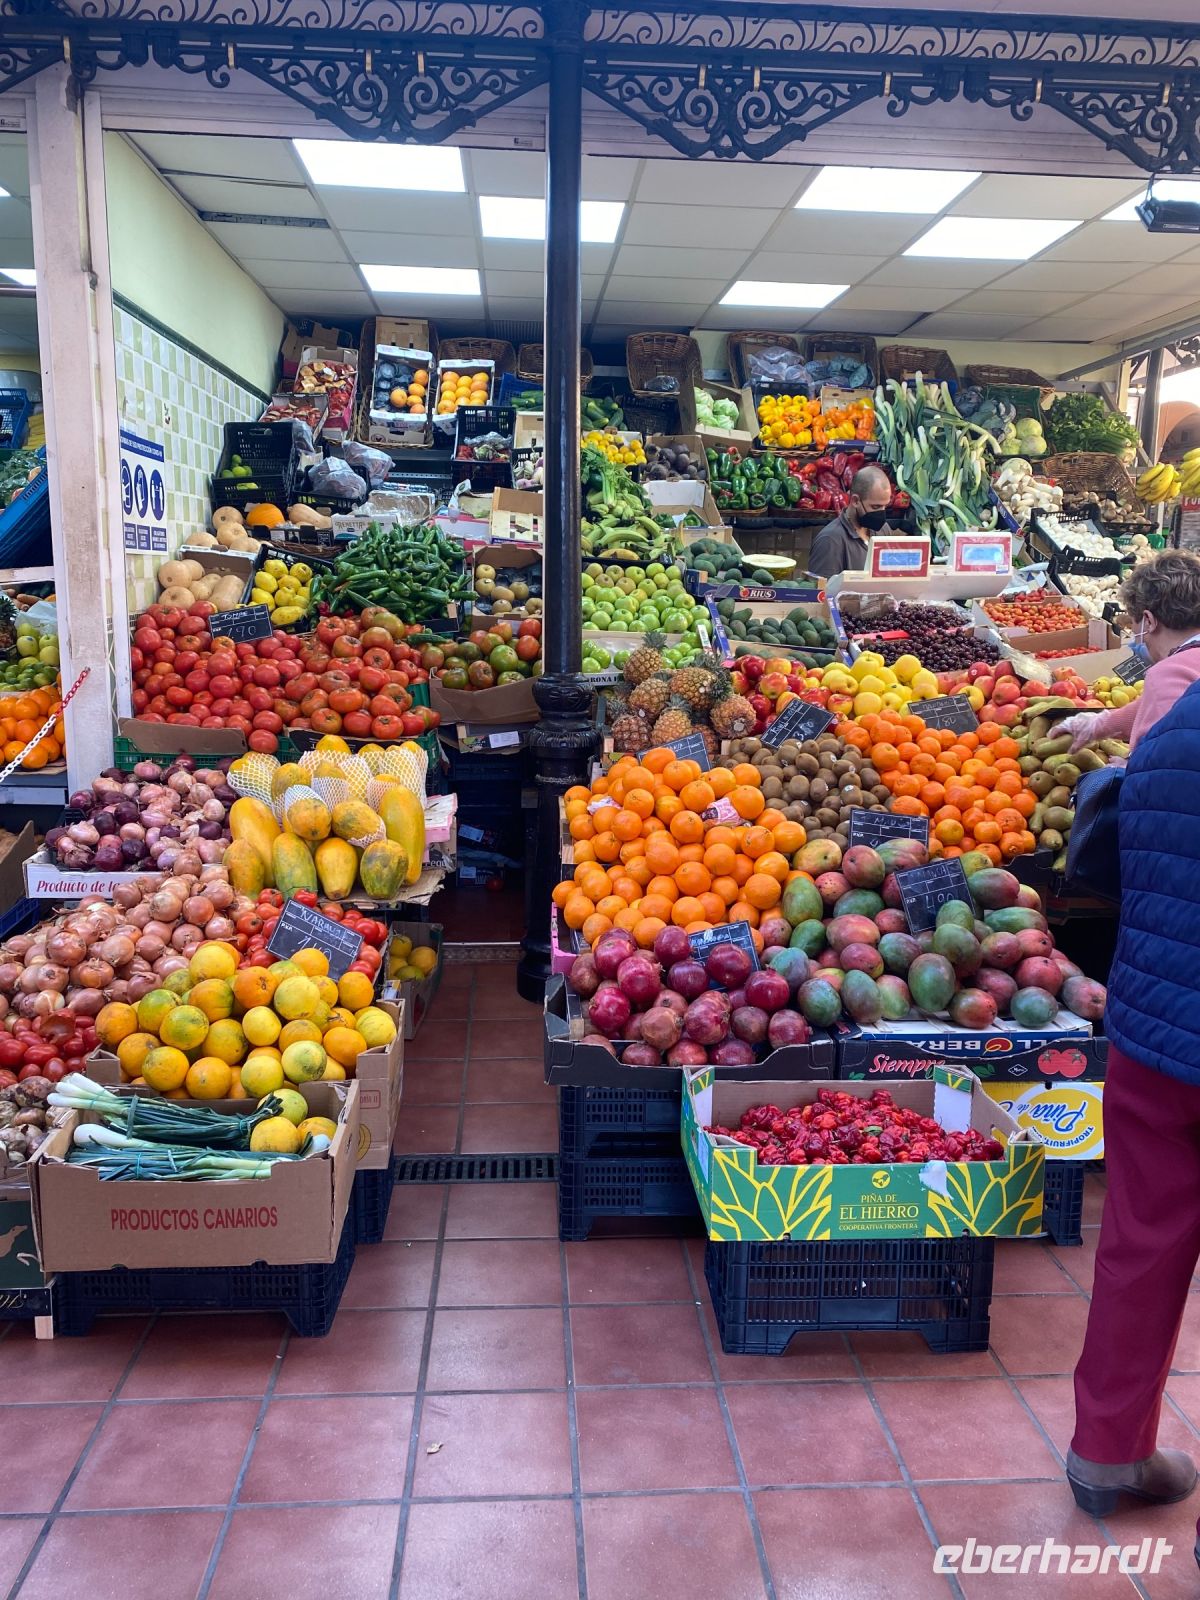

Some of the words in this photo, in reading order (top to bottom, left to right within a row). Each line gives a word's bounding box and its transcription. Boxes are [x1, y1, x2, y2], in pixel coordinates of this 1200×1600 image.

[36, 880, 87, 893] Producto
[90, 880, 105, 893] de
[1017, 1103, 1030, 1114] de
[1032, 1101, 1087, 1132] Piña
[861, 1192, 882, 1203] PIÑA
[885, 1194, 897, 1203] DE
[111, 1208, 199, 1231] PRODUCTOS
[203, 1206, 278, 1230] CANARIOS
[840, 1206, 857, 1220] EL
[861, 1205, 919, 1219] HIERRO
[838, 1223, 883, 1231] COOPERATIVA
[884, 1222, 918, 1230] FRONTERA
